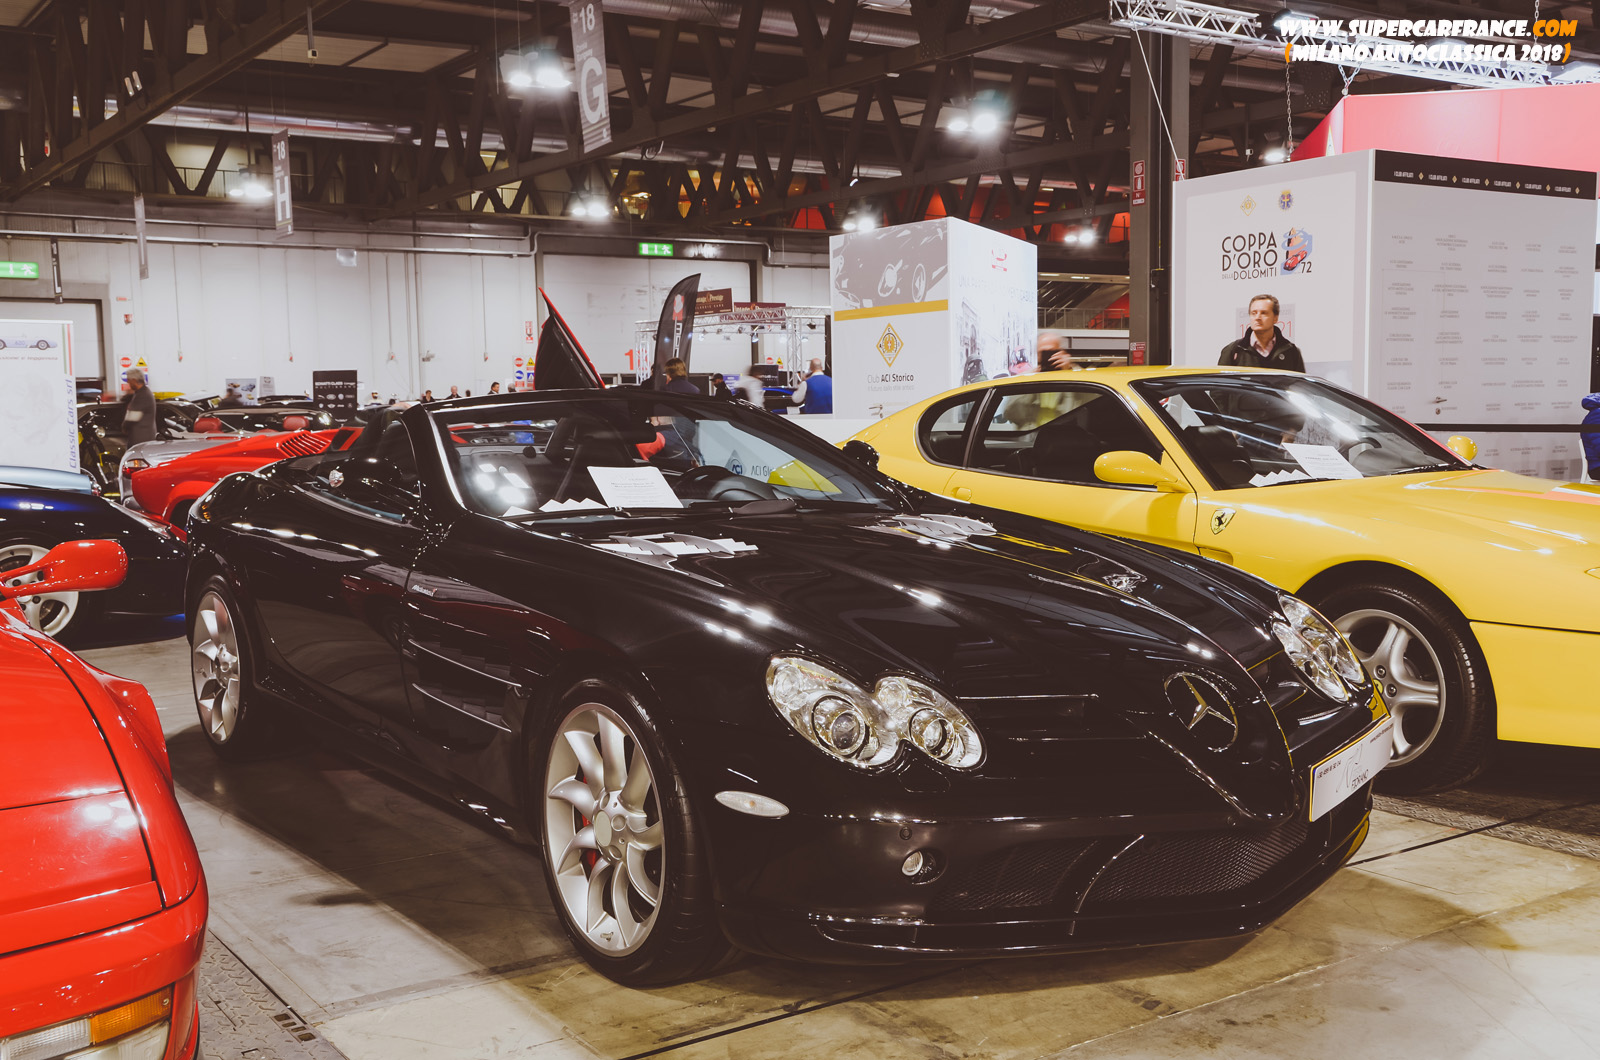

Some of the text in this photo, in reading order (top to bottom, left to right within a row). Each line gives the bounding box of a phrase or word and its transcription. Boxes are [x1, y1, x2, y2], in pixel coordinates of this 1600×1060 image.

[580, 3, 595, 33] 18
[581, 57, 606, 124] G
[277, 140, 286, 160] 18
[276, 175, 290, 221] H
[1222, 232, 1277, 253] COPPA
[1222, 249, 1278, 271] D'ORO
[1301, 261, 1312, 273] 72
[54, 265, 62, 293] L
[1233, 267, 1277, 280] DOLOMITI
[881, 374, 891, 382] ACI
[892, 373, 914, 382] Storico
[69, 430, 77, 468] Classic
[732, 464, 743, 475] ACI
[750, 465, 761, 476] ACI
